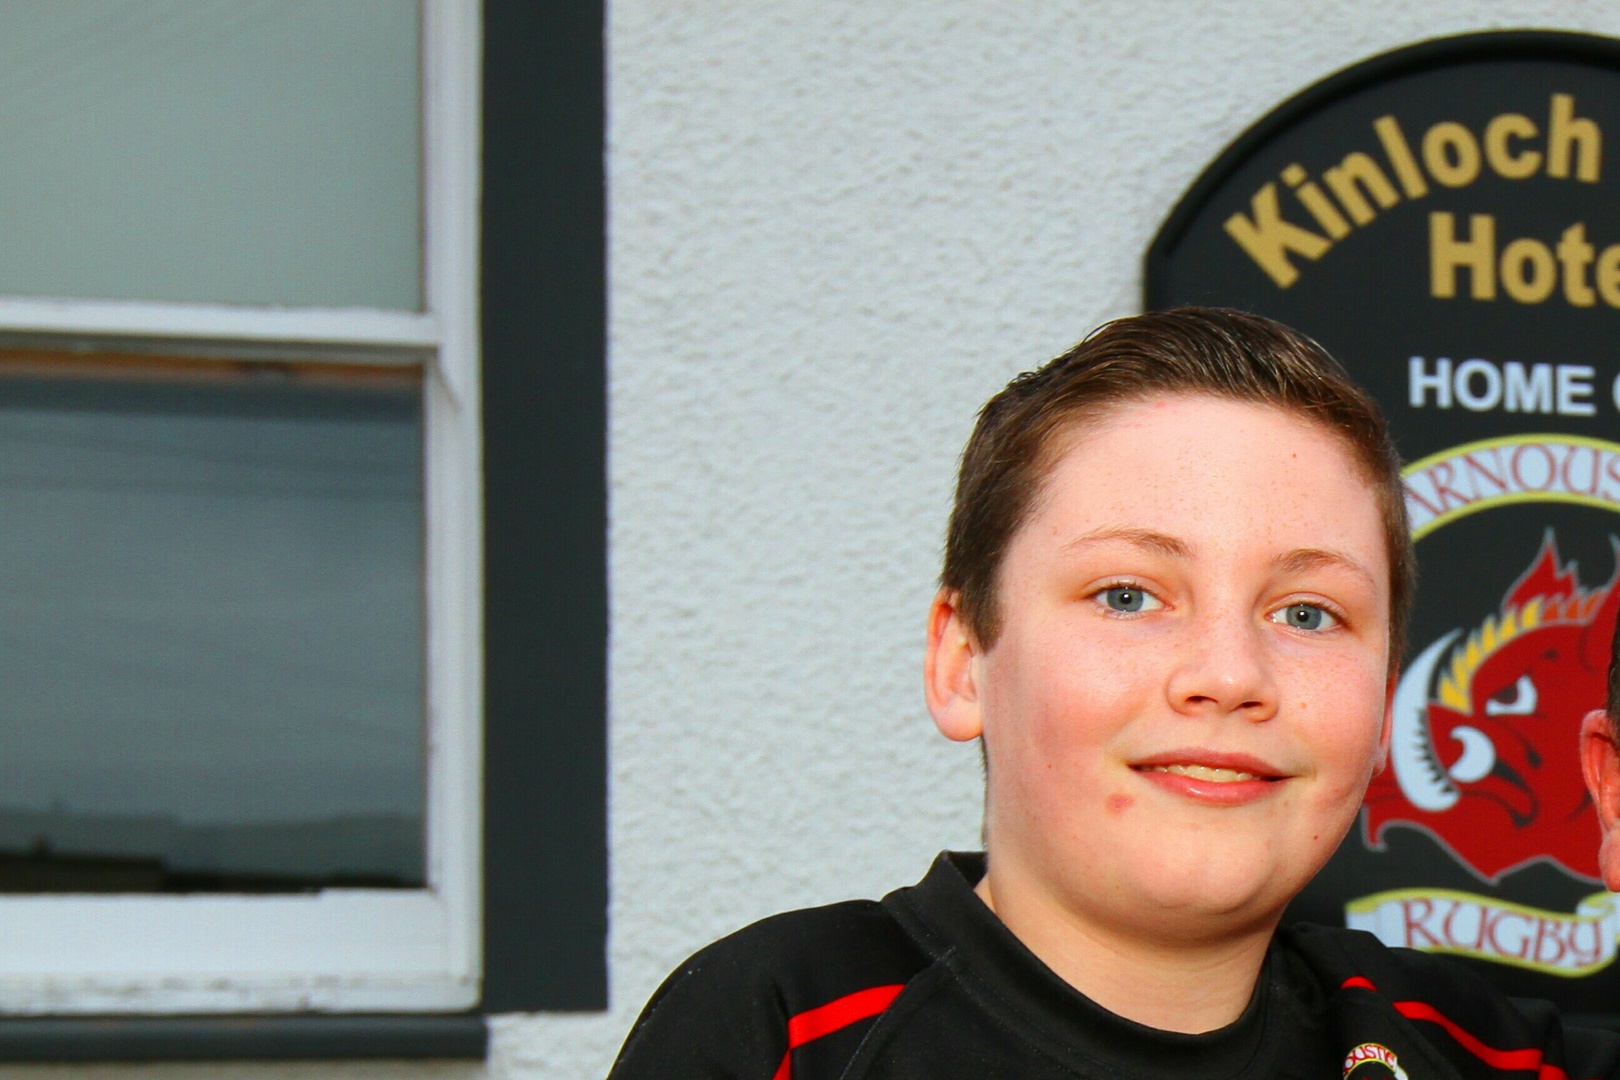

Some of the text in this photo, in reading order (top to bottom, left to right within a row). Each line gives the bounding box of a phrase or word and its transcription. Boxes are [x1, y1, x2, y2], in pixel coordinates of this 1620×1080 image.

[1223, 93, 1601, 289] Kinloch
[1408, 356, 1595, 417] HOME
[1403, 898, 1603, 967] RUGBY
